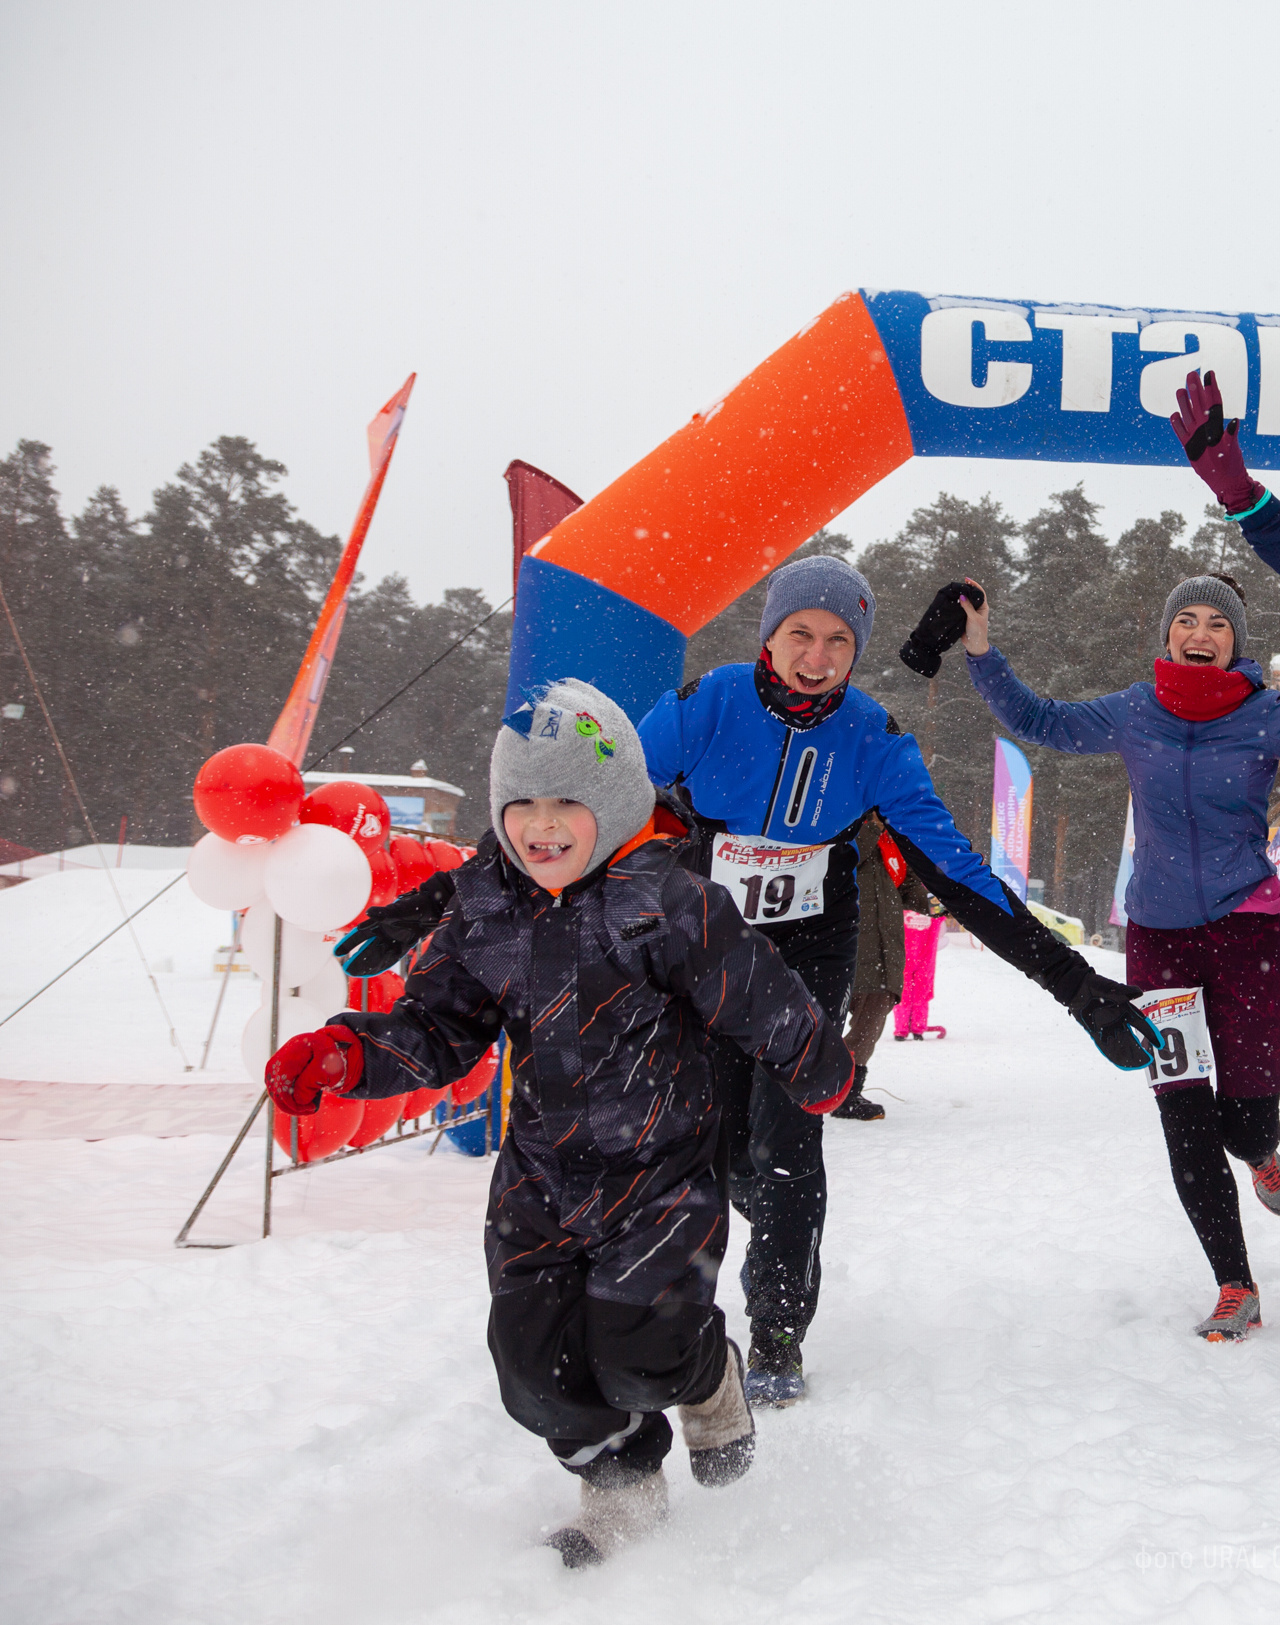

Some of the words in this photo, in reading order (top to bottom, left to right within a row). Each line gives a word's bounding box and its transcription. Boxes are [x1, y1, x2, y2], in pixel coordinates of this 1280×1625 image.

[820, 751, 836, 795] VICTORY
[810, 798, 823, 827] CODE
[739, 874, 796, 919] 19
